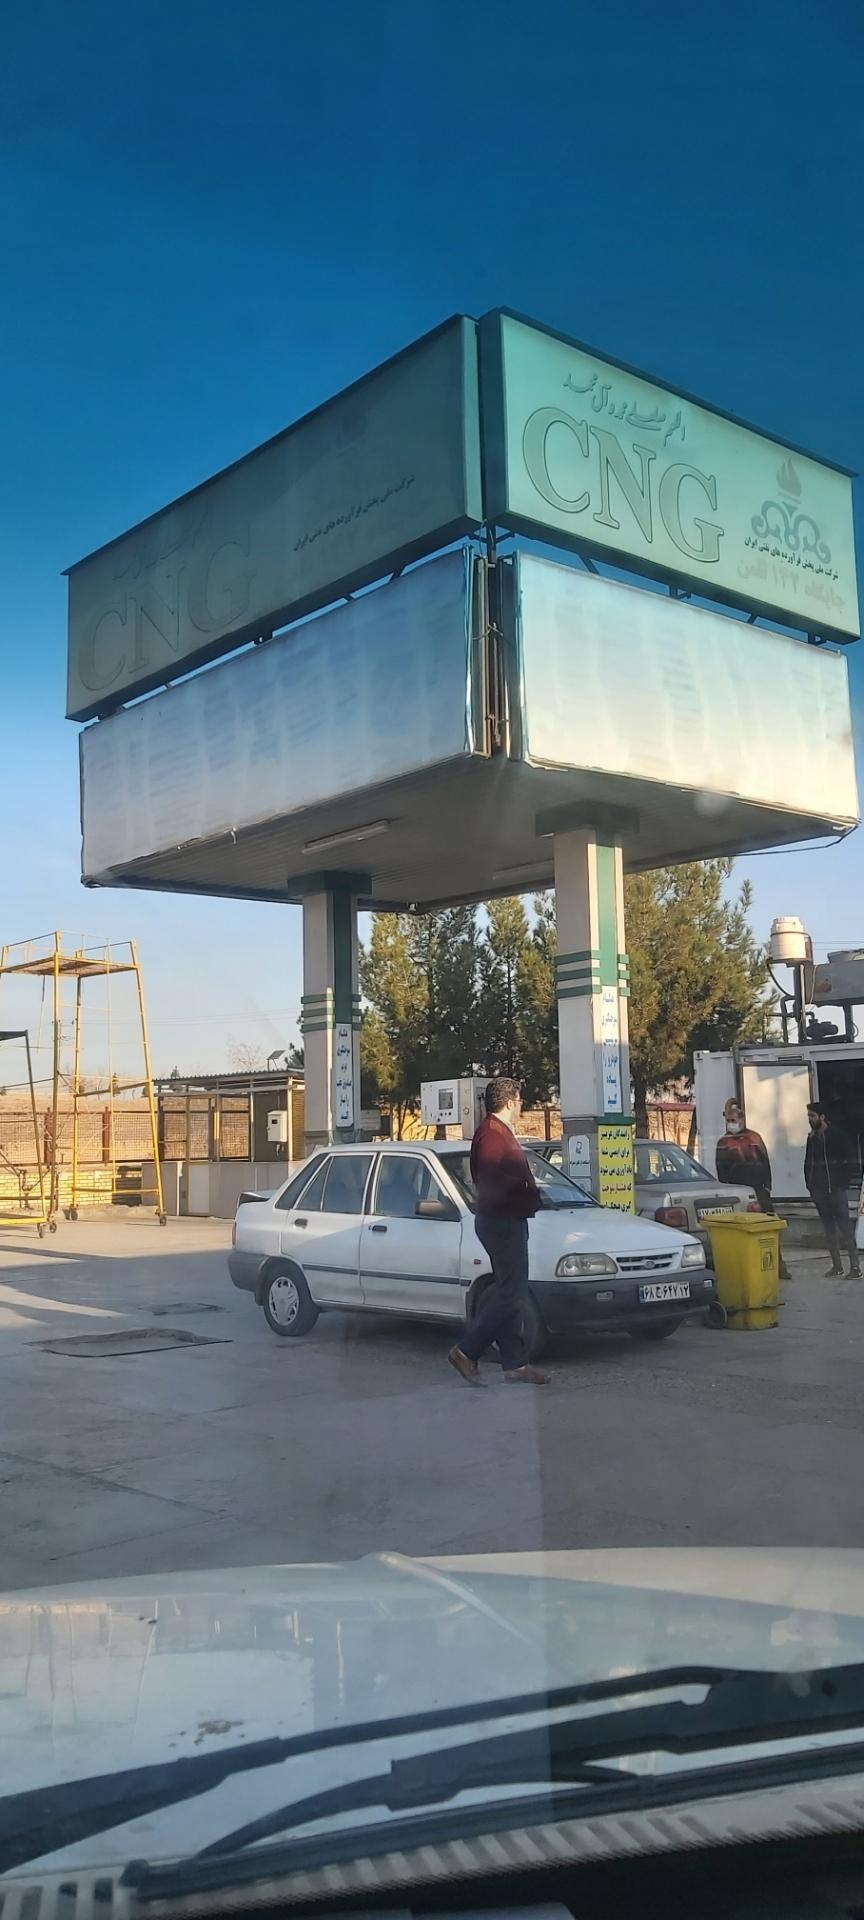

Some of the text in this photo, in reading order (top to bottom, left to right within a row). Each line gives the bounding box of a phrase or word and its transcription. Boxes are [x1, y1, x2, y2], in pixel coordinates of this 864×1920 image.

[394, 474, 415, 493] شرکت
[522, 406, 725, 563] CNG
[380, 488, 393, 503] ملی
[744, 536, 758, 549] ایران
[758, 543, 770, 552] نفتی
[801, 560, 815, 572] پخش
[814, 564, 824, 575] ملی
[824, 569, 839, 581] شرکت
[78, 521, 258, 691] CNG
[609, 1147, 620, 1159] ایمنی
[621, 1147, 630, 1159] برای
[644, 1287, 654, 1299] ۶۸
[663, 1285, 678, 1298] ۶۴۷
[680, 1285, 689, 1297] ۱۲
